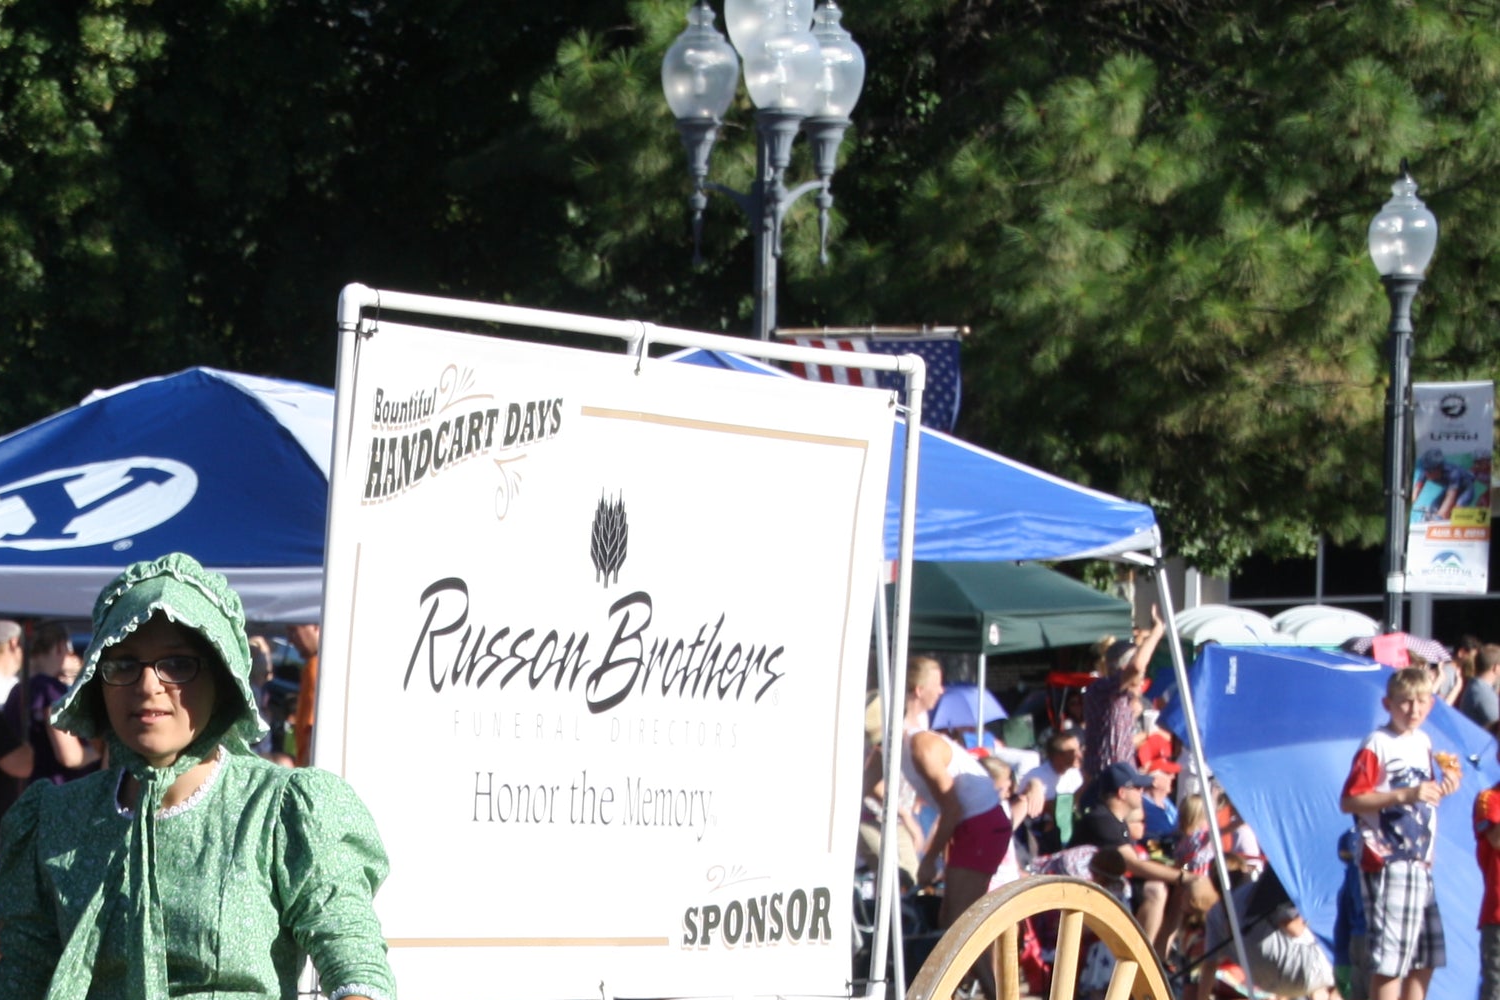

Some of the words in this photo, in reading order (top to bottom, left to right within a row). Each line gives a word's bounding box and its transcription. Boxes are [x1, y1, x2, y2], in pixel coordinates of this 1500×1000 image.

[374, 387, 438, 423] Bountiful
[364, 408, 500, 499] HANDCART
[502, 397, 564, 447] DAYS
[1429, 431, 1479, 441] UTAH
[403, 577, 592, 694] Russon
[586, 591, 786, 715] Brothers
[453, 709, 581, 743] FUNERAL
[610, 716, 738, 750] DIRECTORS
[471, 771, 560, 824] Honor
[569, 769, 615, 826] the
[622, 776, 713, 843] Memory
[682, 886, 833, 947] SPONSOR
